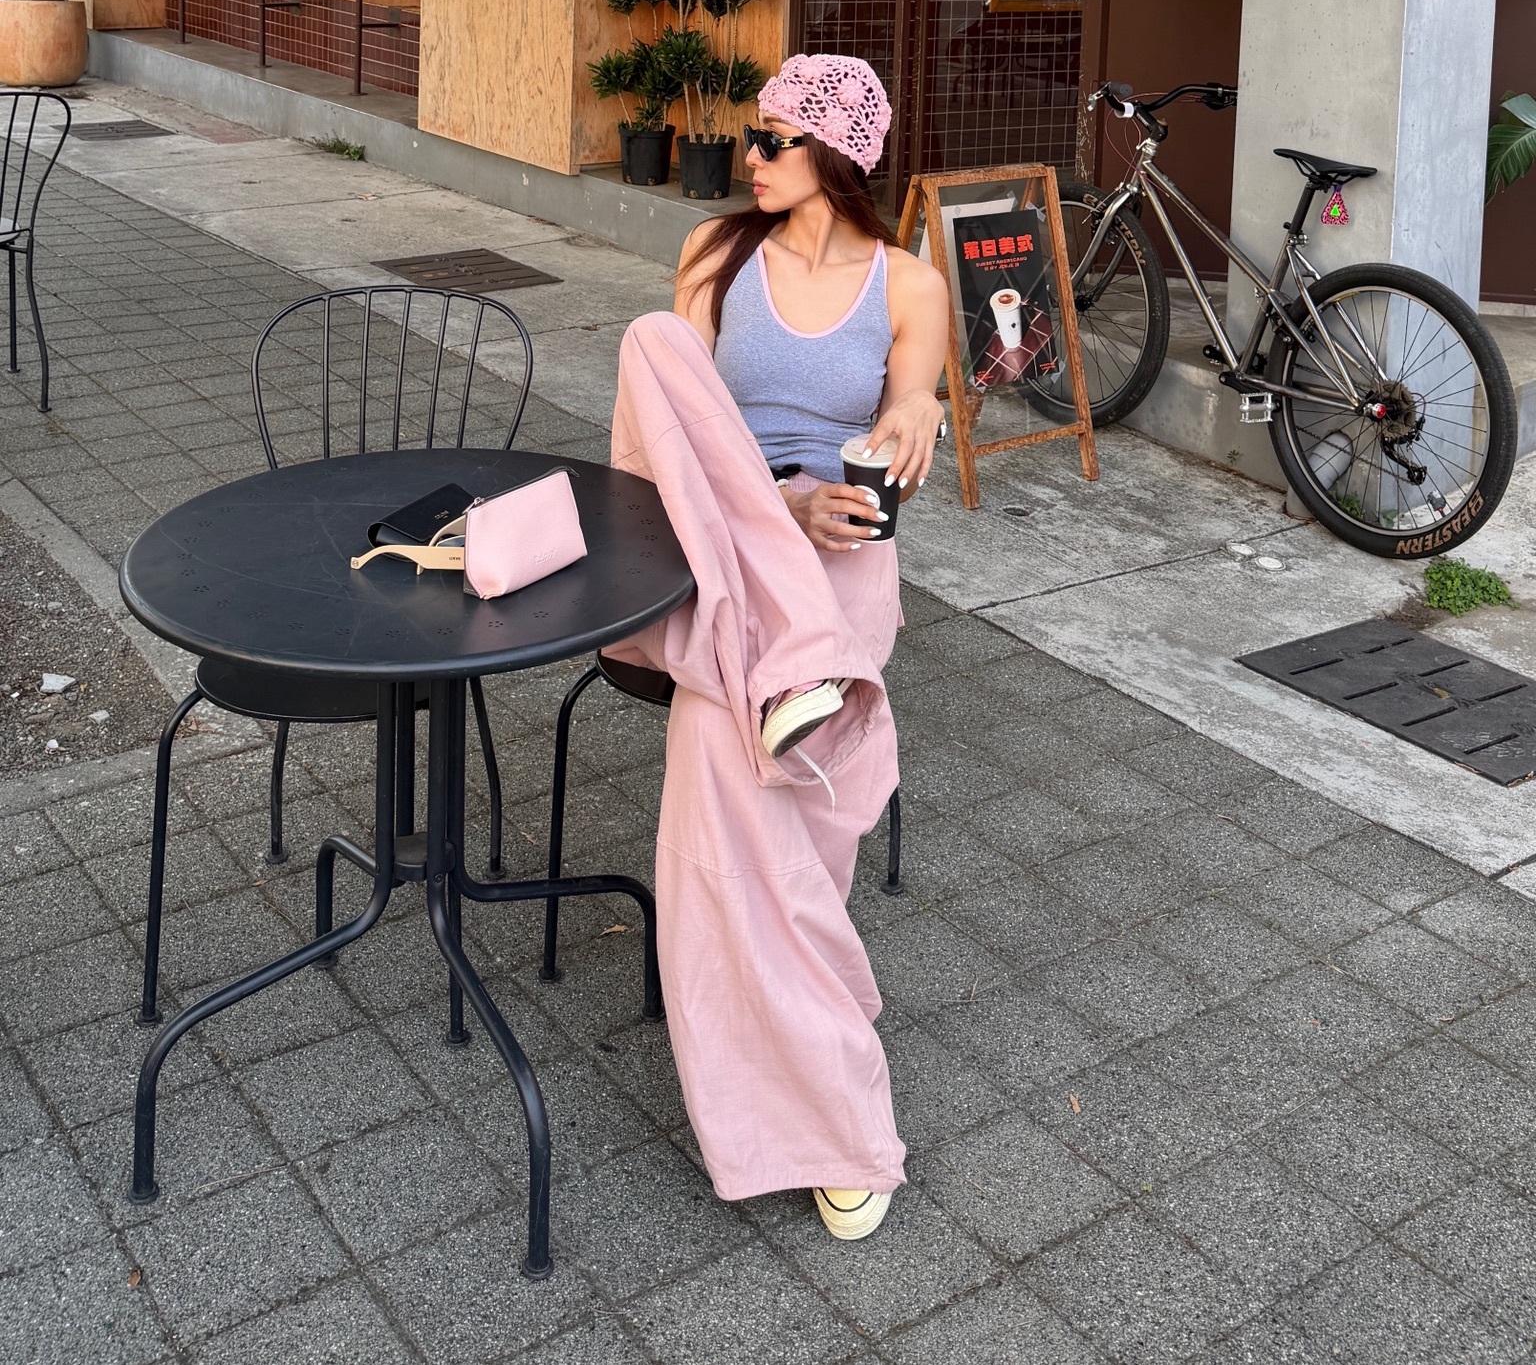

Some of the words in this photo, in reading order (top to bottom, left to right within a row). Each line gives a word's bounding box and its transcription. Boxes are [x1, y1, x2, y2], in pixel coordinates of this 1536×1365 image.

[963, 234, 1033, 260] 落日美式
[975, 260, 996, 268] SUNSET
[996, 256, 1028, 265] AMERICANO
